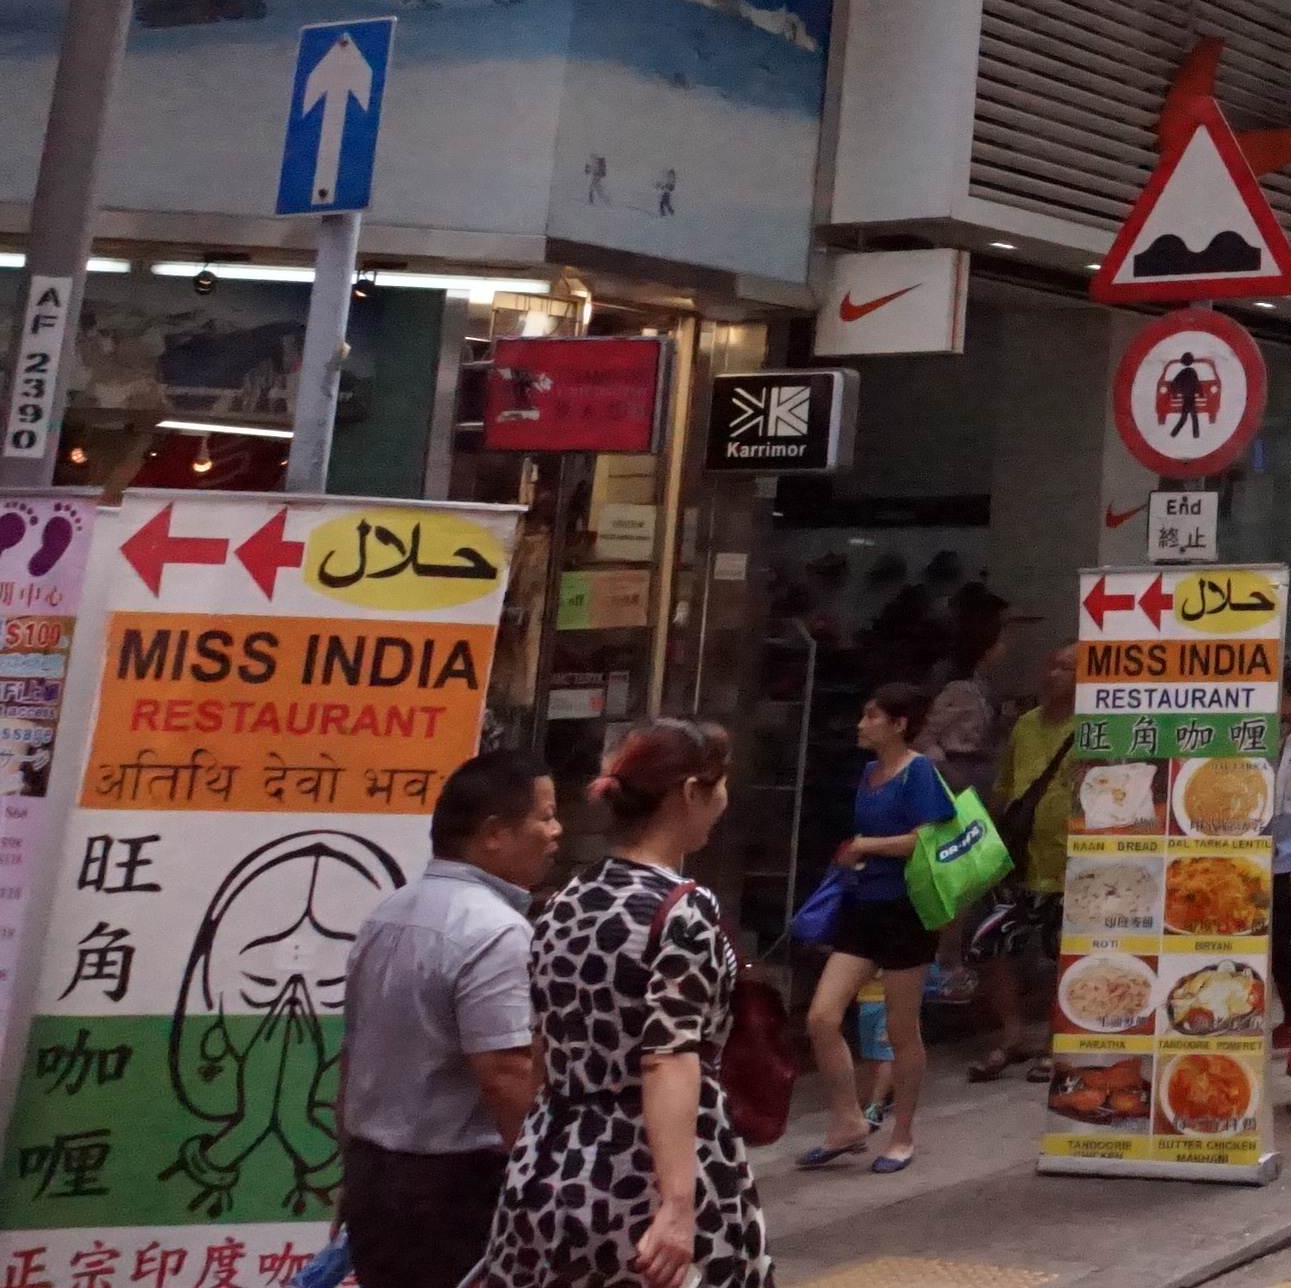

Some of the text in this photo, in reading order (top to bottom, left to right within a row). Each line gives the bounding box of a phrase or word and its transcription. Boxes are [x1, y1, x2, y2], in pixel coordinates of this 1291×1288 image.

[11, 352, 51, 450] 2390
[727, 441, 807, 459] Karrimor
[1166, 499, 1202, 515] End
[1158, 527, 1207, 549] 終止
[318, 520, 498, 588] حلال
[1181, 578, 1275, 621] حلال
[117, 627, 280, 686] MISS
[301, 634, 480, 691] INDIA
[1087, 643, 1271, 676] MISS INDIA
[1095, 688, 1255, 709] RESTAURANT
[130, 697, 446, 740] RESTAURANT
[1079, 716, 1267, 755] 旺角咖喱
[1117, 842, 1158, 852] BREAD
[1168, 839, 1272, 850] DAL TARKA LENTIL
[1092, 940, 1119, 950] ROTI
[1195, 941, 1233, 951] BIRYANI
[1079, 1040, 1126, 1050] PARATHA
[1158, 1140, 1257, 1152] BUTTER CHICKEN
